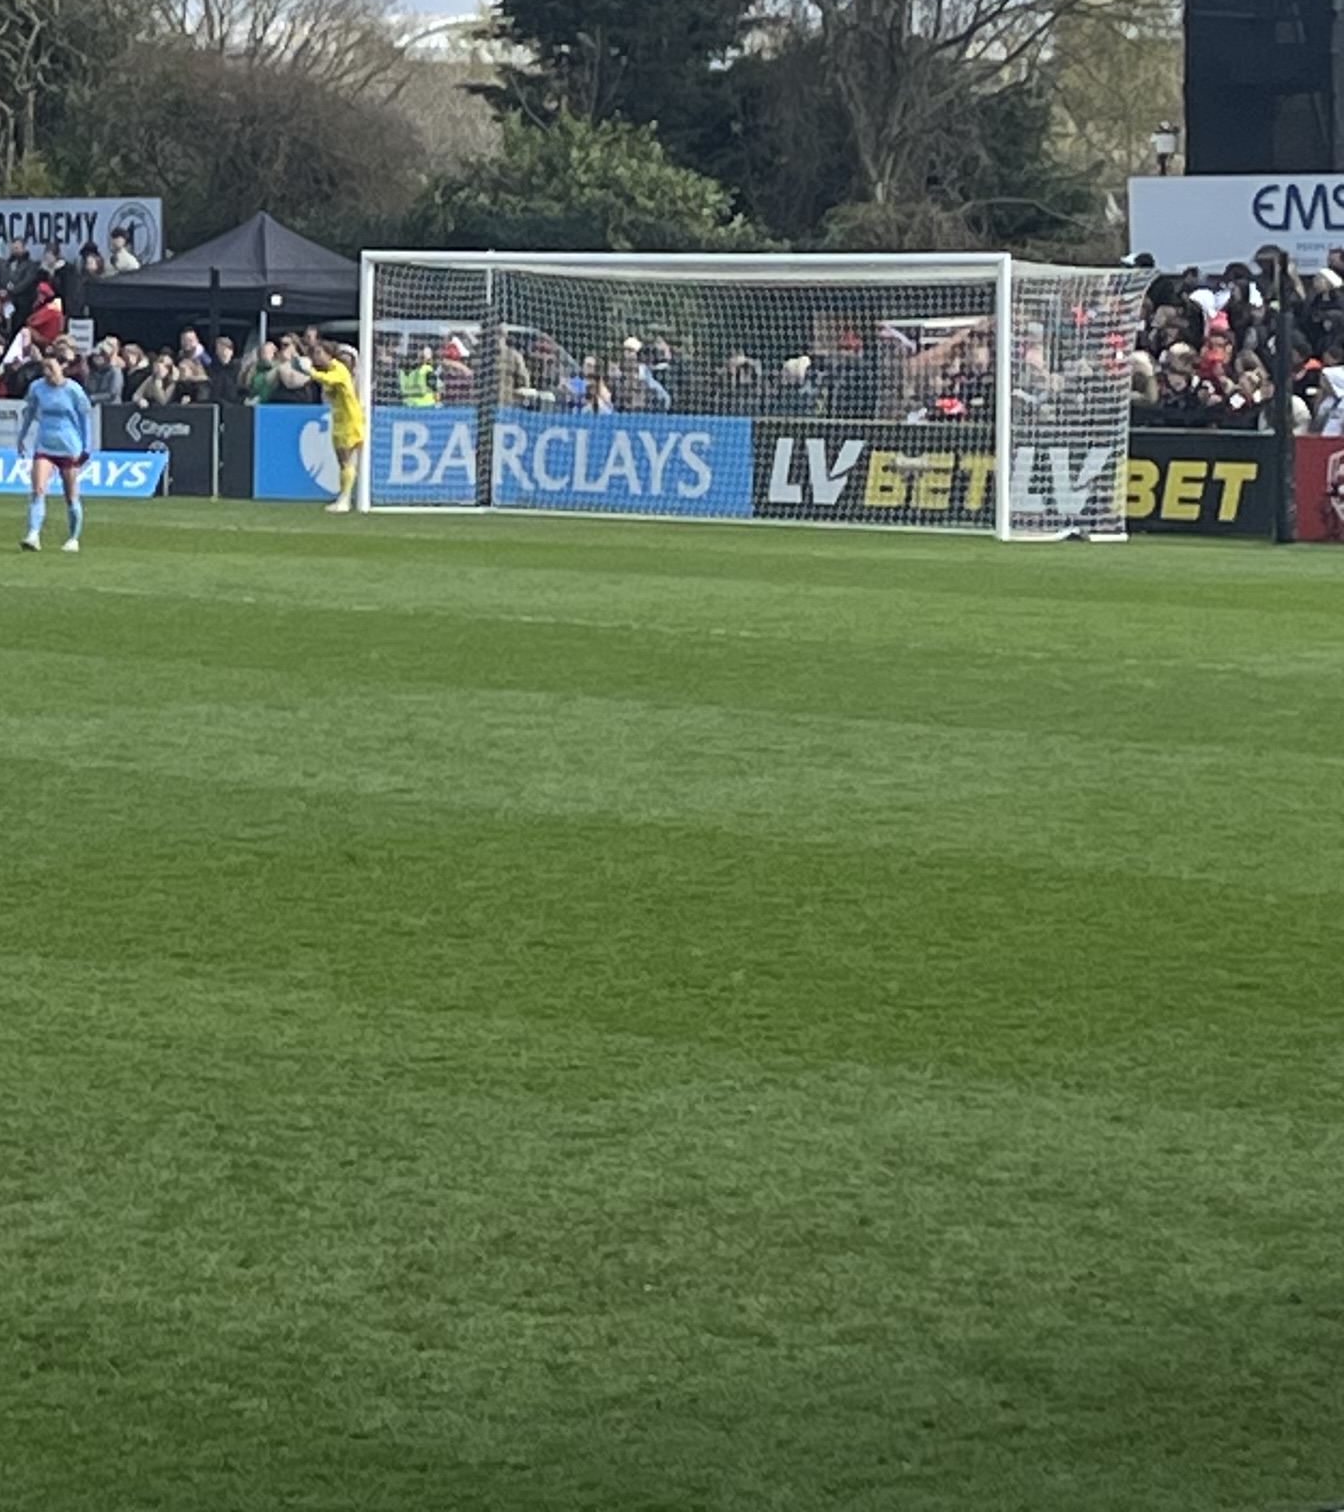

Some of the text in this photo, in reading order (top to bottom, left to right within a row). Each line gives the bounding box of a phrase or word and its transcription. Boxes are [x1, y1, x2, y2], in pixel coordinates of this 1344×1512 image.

[386, 421, 712, 499] BARCLAYS
[767, 437, 997, 511] LV BET
[1012, 446, 1259, 522] LV BET
